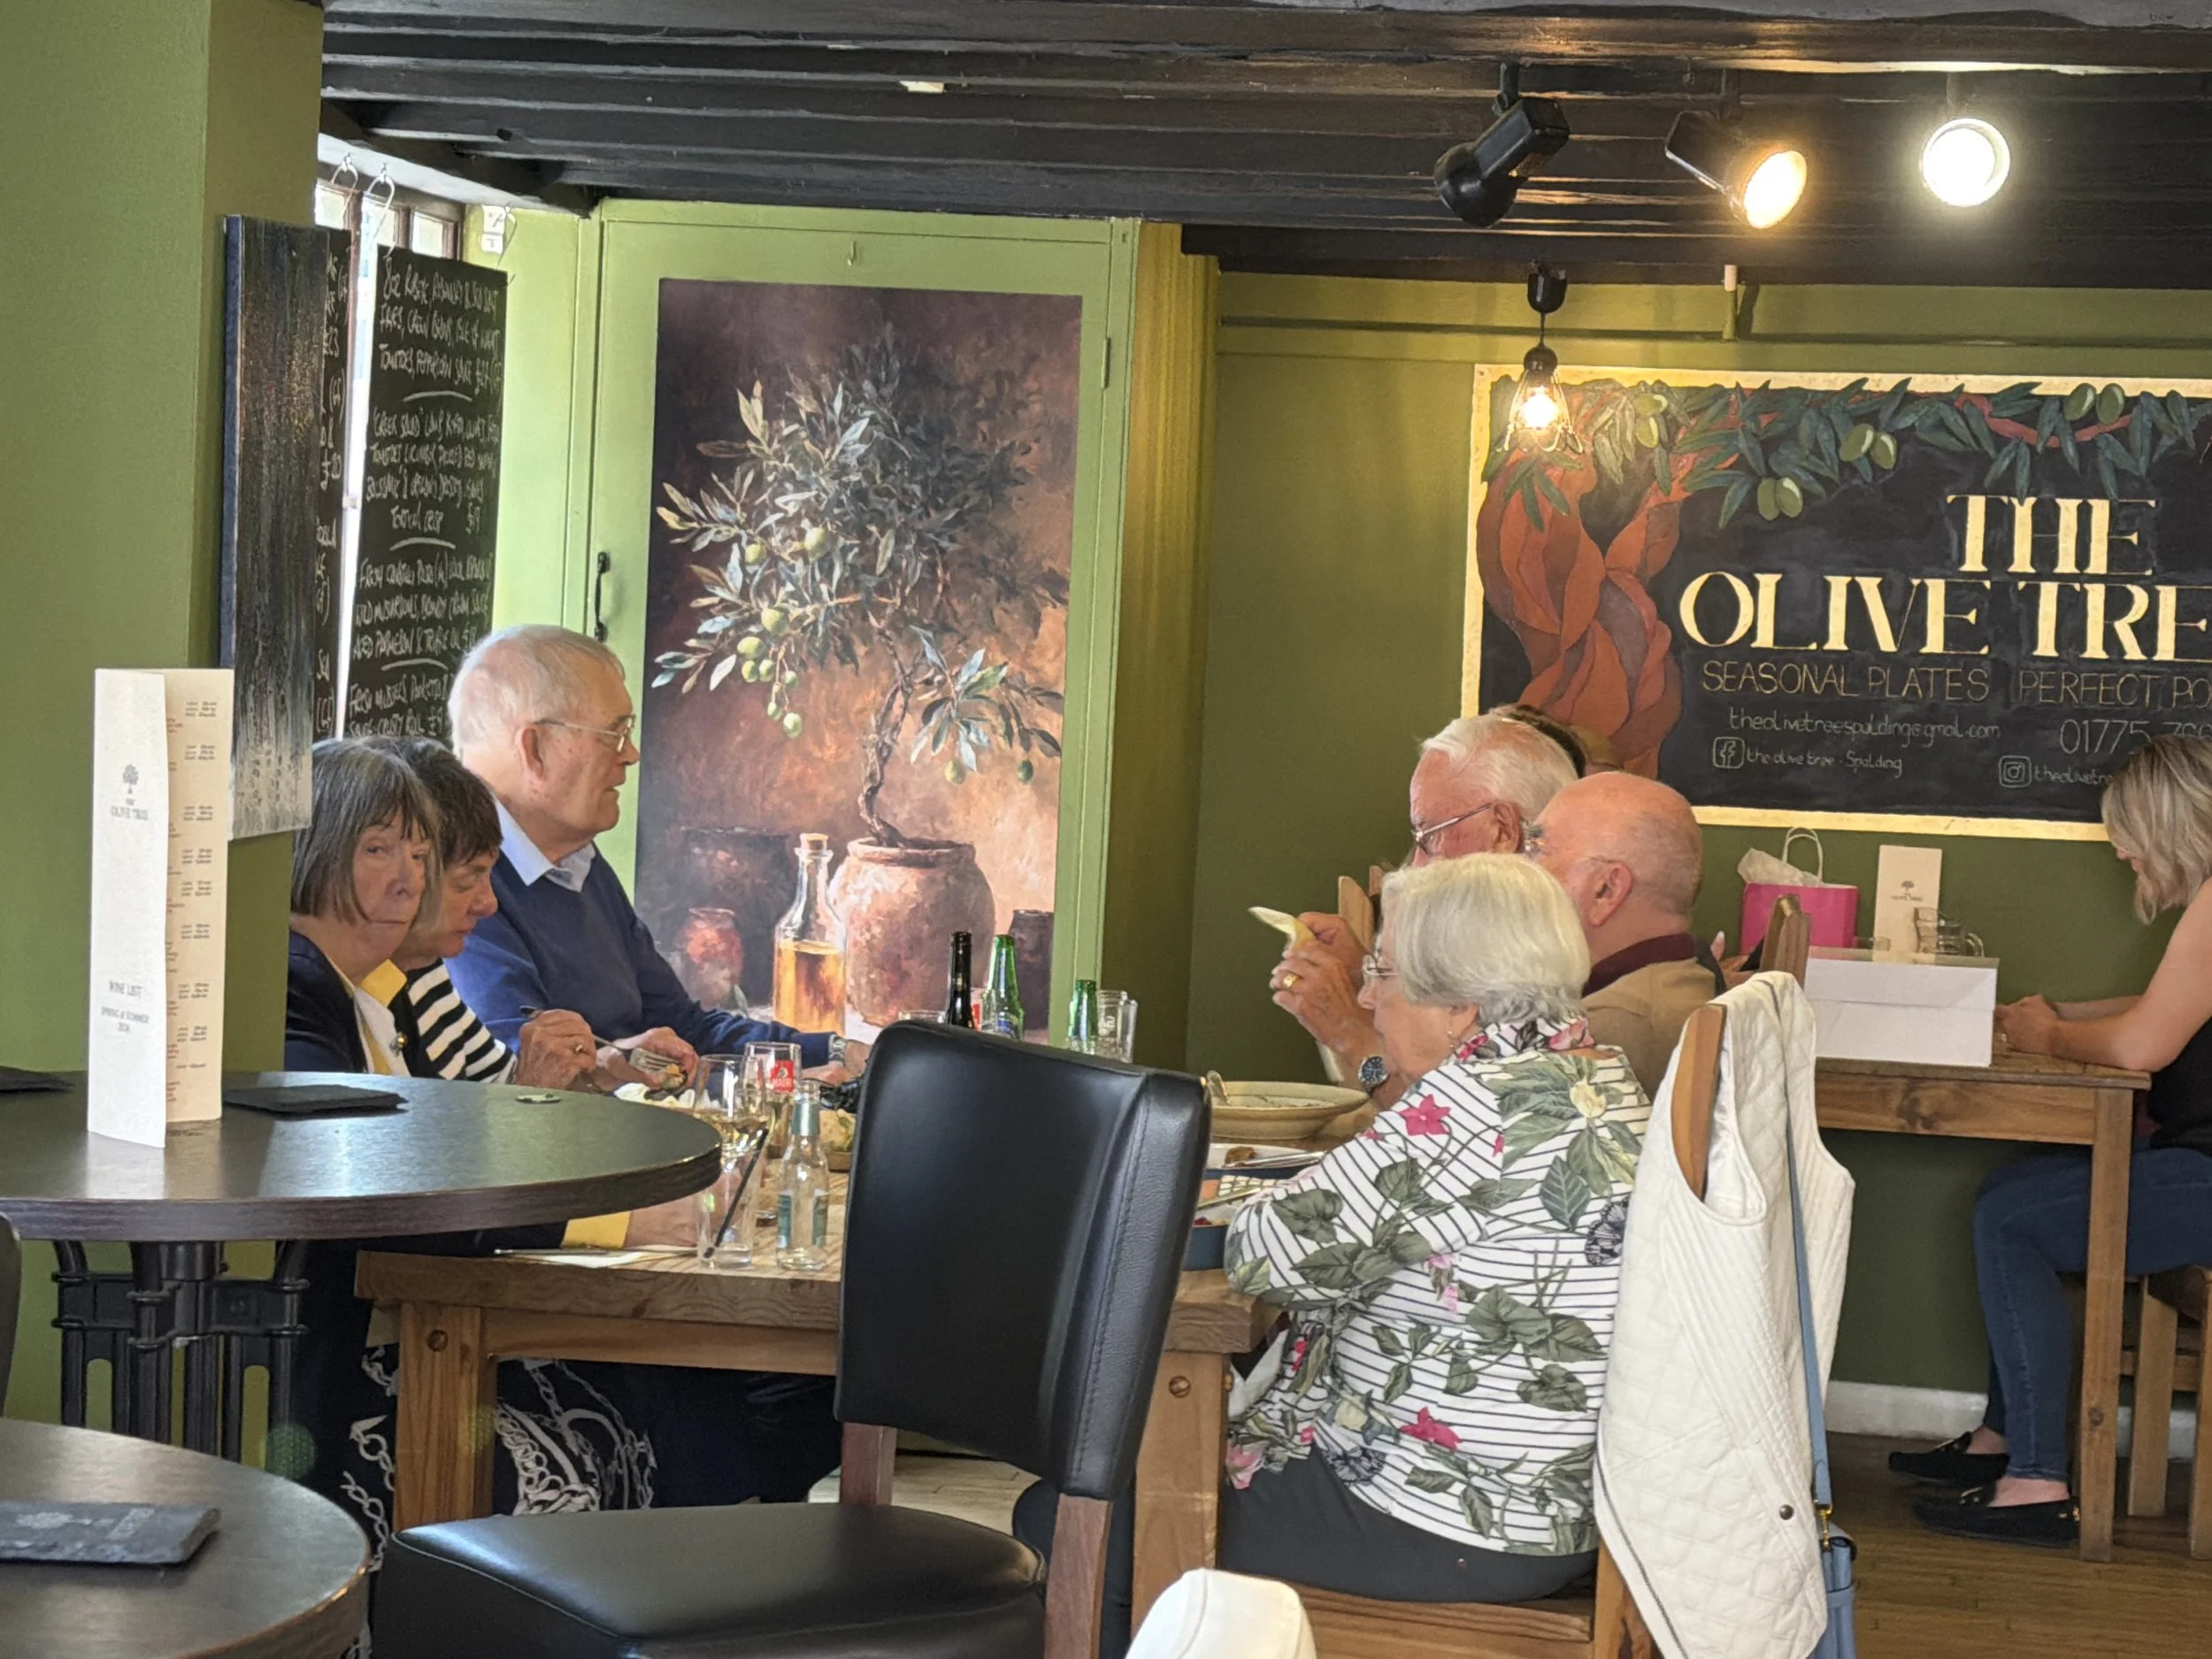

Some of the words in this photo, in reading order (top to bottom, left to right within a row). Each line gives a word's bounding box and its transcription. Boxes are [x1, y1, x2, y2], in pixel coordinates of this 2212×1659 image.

[1947, 494, 2156, 575] THE
[1679, 571, 1991, 655] OLIVE
[1702, 659, 1860, 698] SEASONAL
[1869, 666, 1989, 702] PLATES
[2018, 671, 2162, 707] PERFECT
[2060, 718, 2152, 755] 01775
[1846, 749, 1903, 779] Spalding
